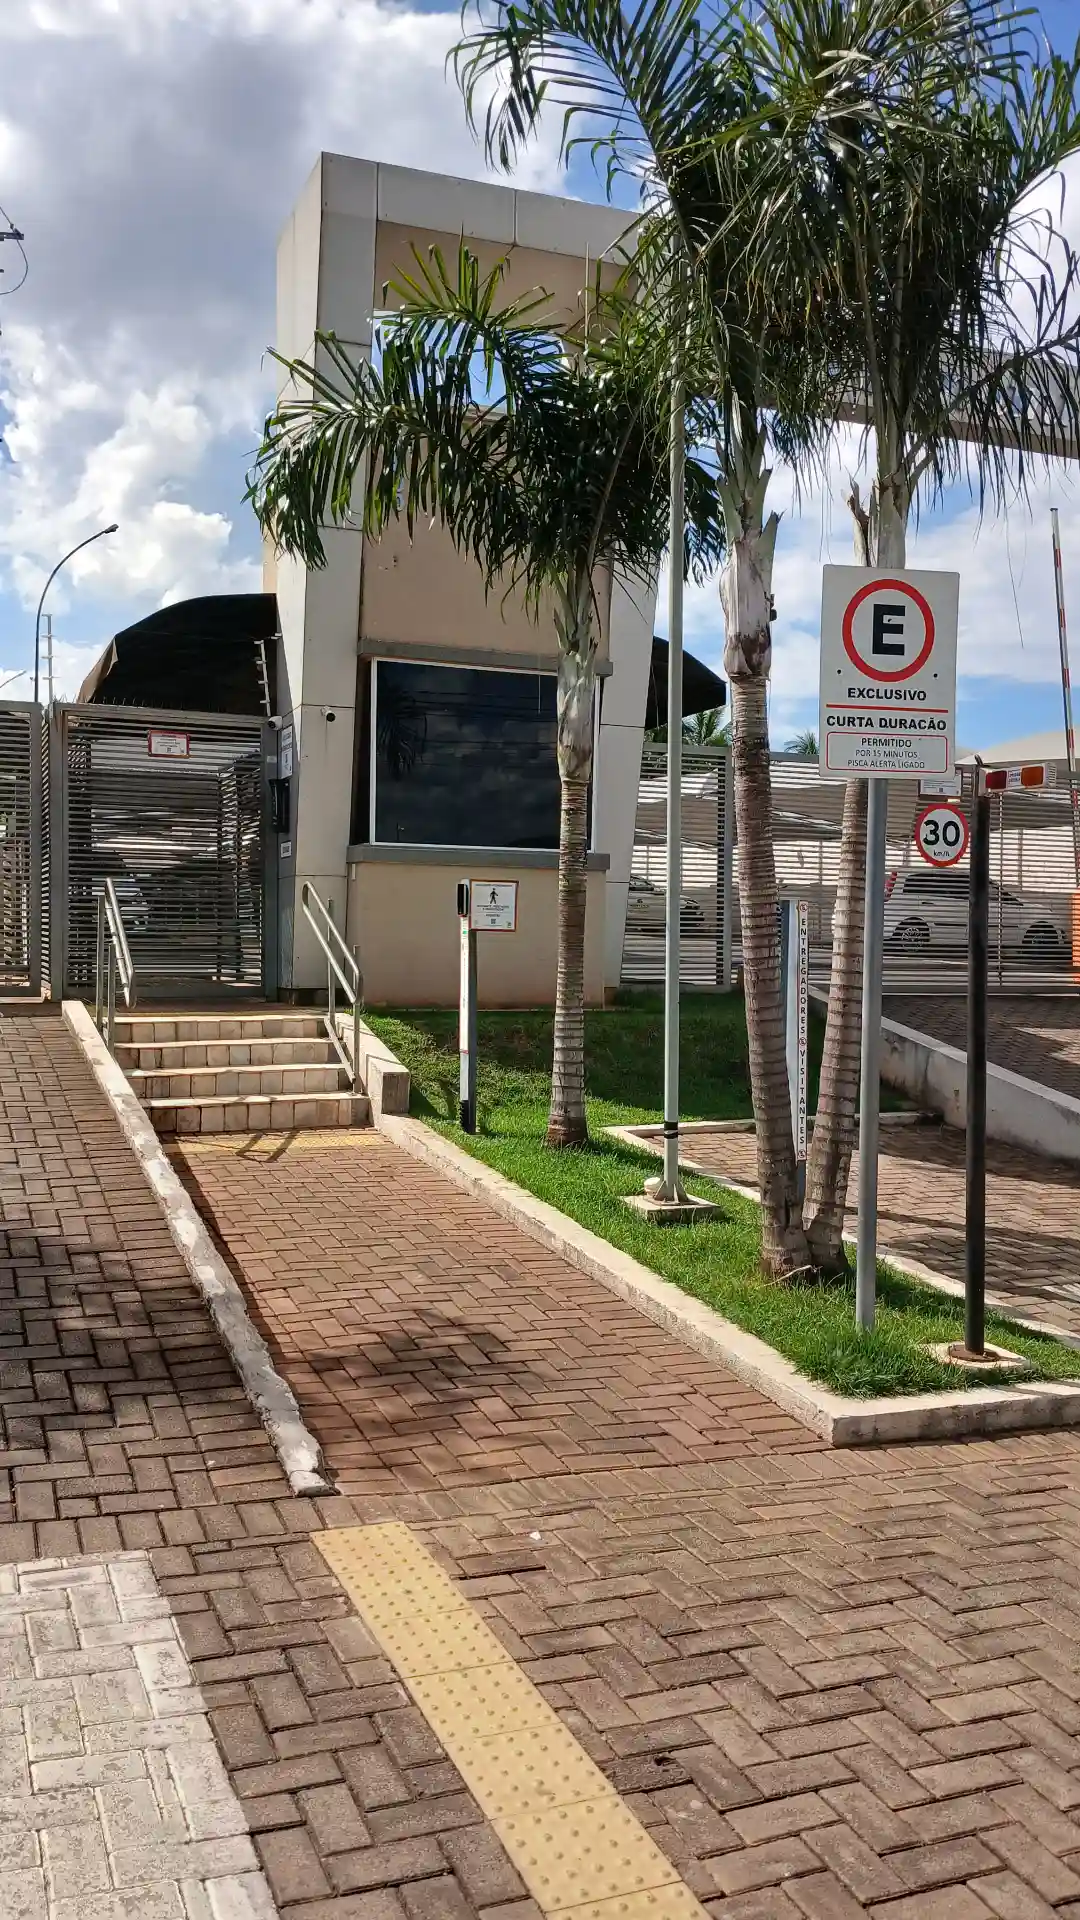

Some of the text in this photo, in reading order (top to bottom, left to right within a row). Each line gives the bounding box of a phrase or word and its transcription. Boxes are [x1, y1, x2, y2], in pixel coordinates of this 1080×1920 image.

[872, 603, 906, 656] E
[847, 687, 927, 701] EXCLUSIVO
[826, 715, 874, 728] CURTA
[861, 737, 912, 747] PERMITIDO
[855, 749, 918, 758] POR 15 MINUTOS
[847, 759, 925, 769] PISCA ALERTA LIGADO
[923, 819, 960, 847] 30
